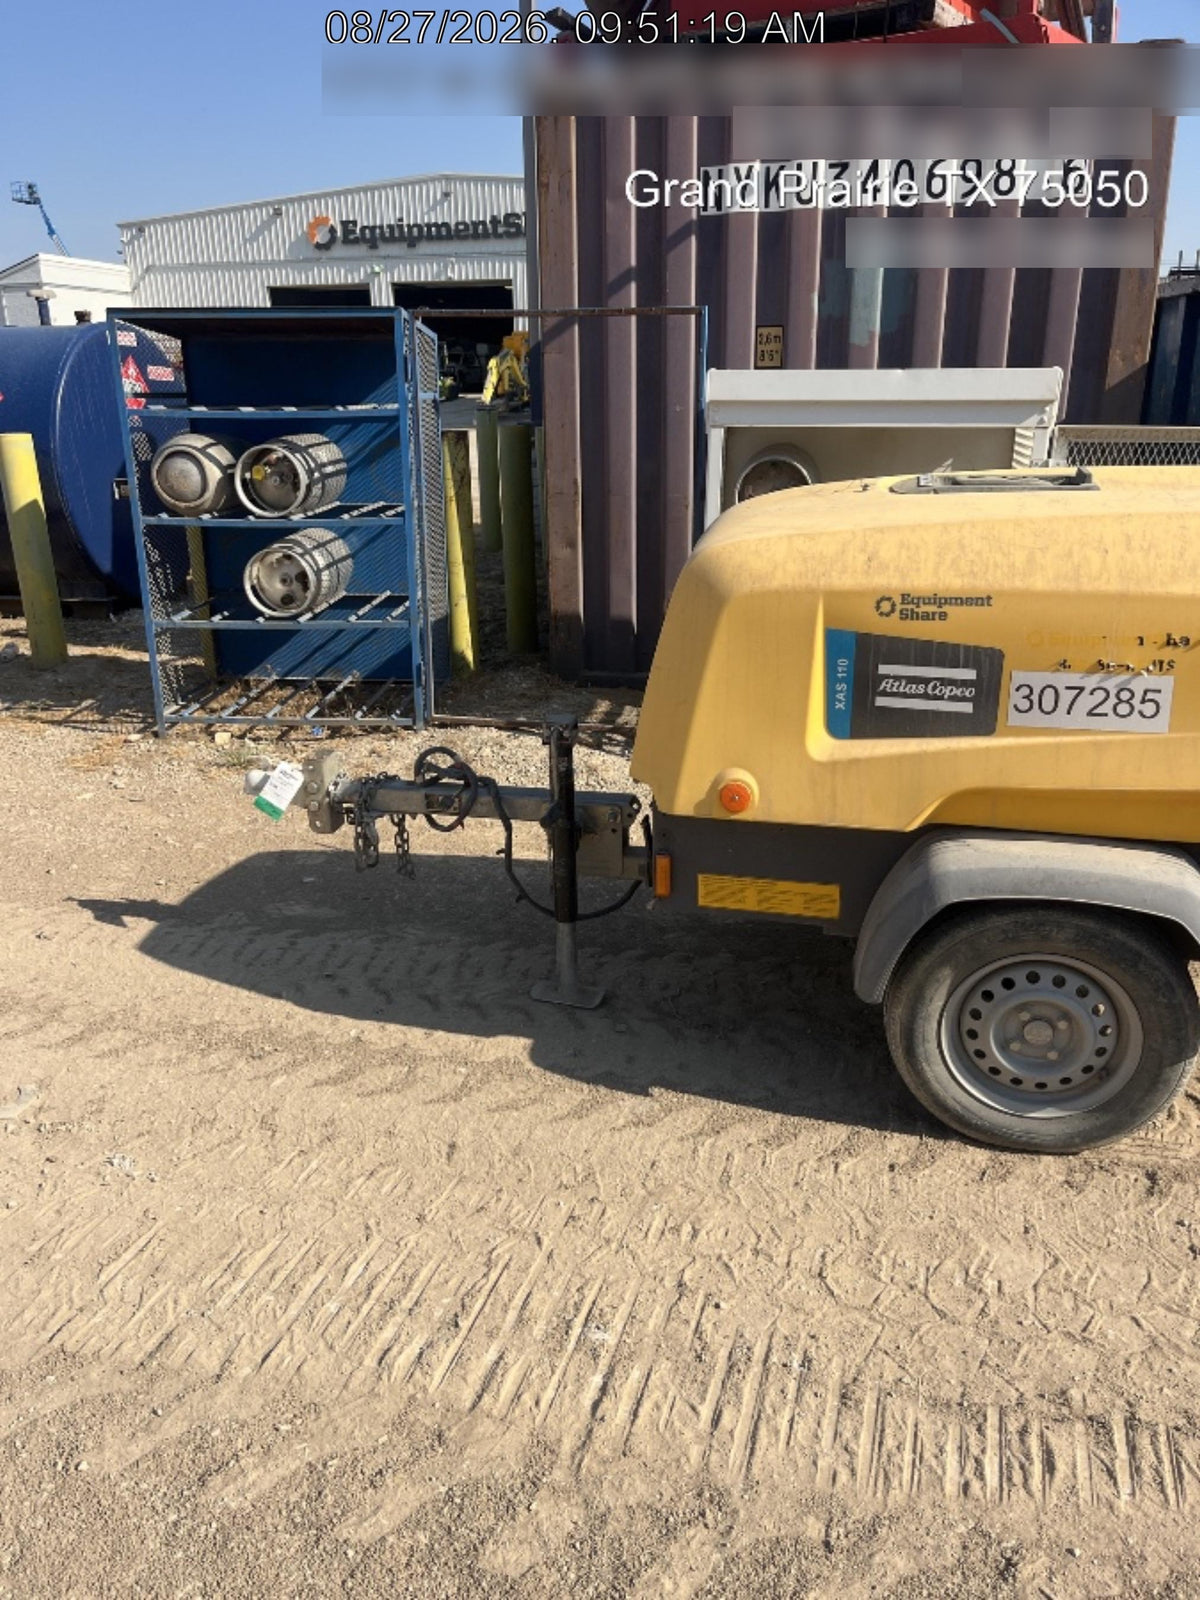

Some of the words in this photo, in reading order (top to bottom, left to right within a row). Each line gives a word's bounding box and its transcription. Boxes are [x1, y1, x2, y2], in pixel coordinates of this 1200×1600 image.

[900, 593, 992, 608] Equipment
[899, 608, 948, 621] Share
[837, 658, 848, 679] 110
[835, 683, 847, 710] XAS
[877, 678, 925, 695] Atlas
[927, 681, 975, 699] Copco
[1013, 684, 1162, 719] 307285
